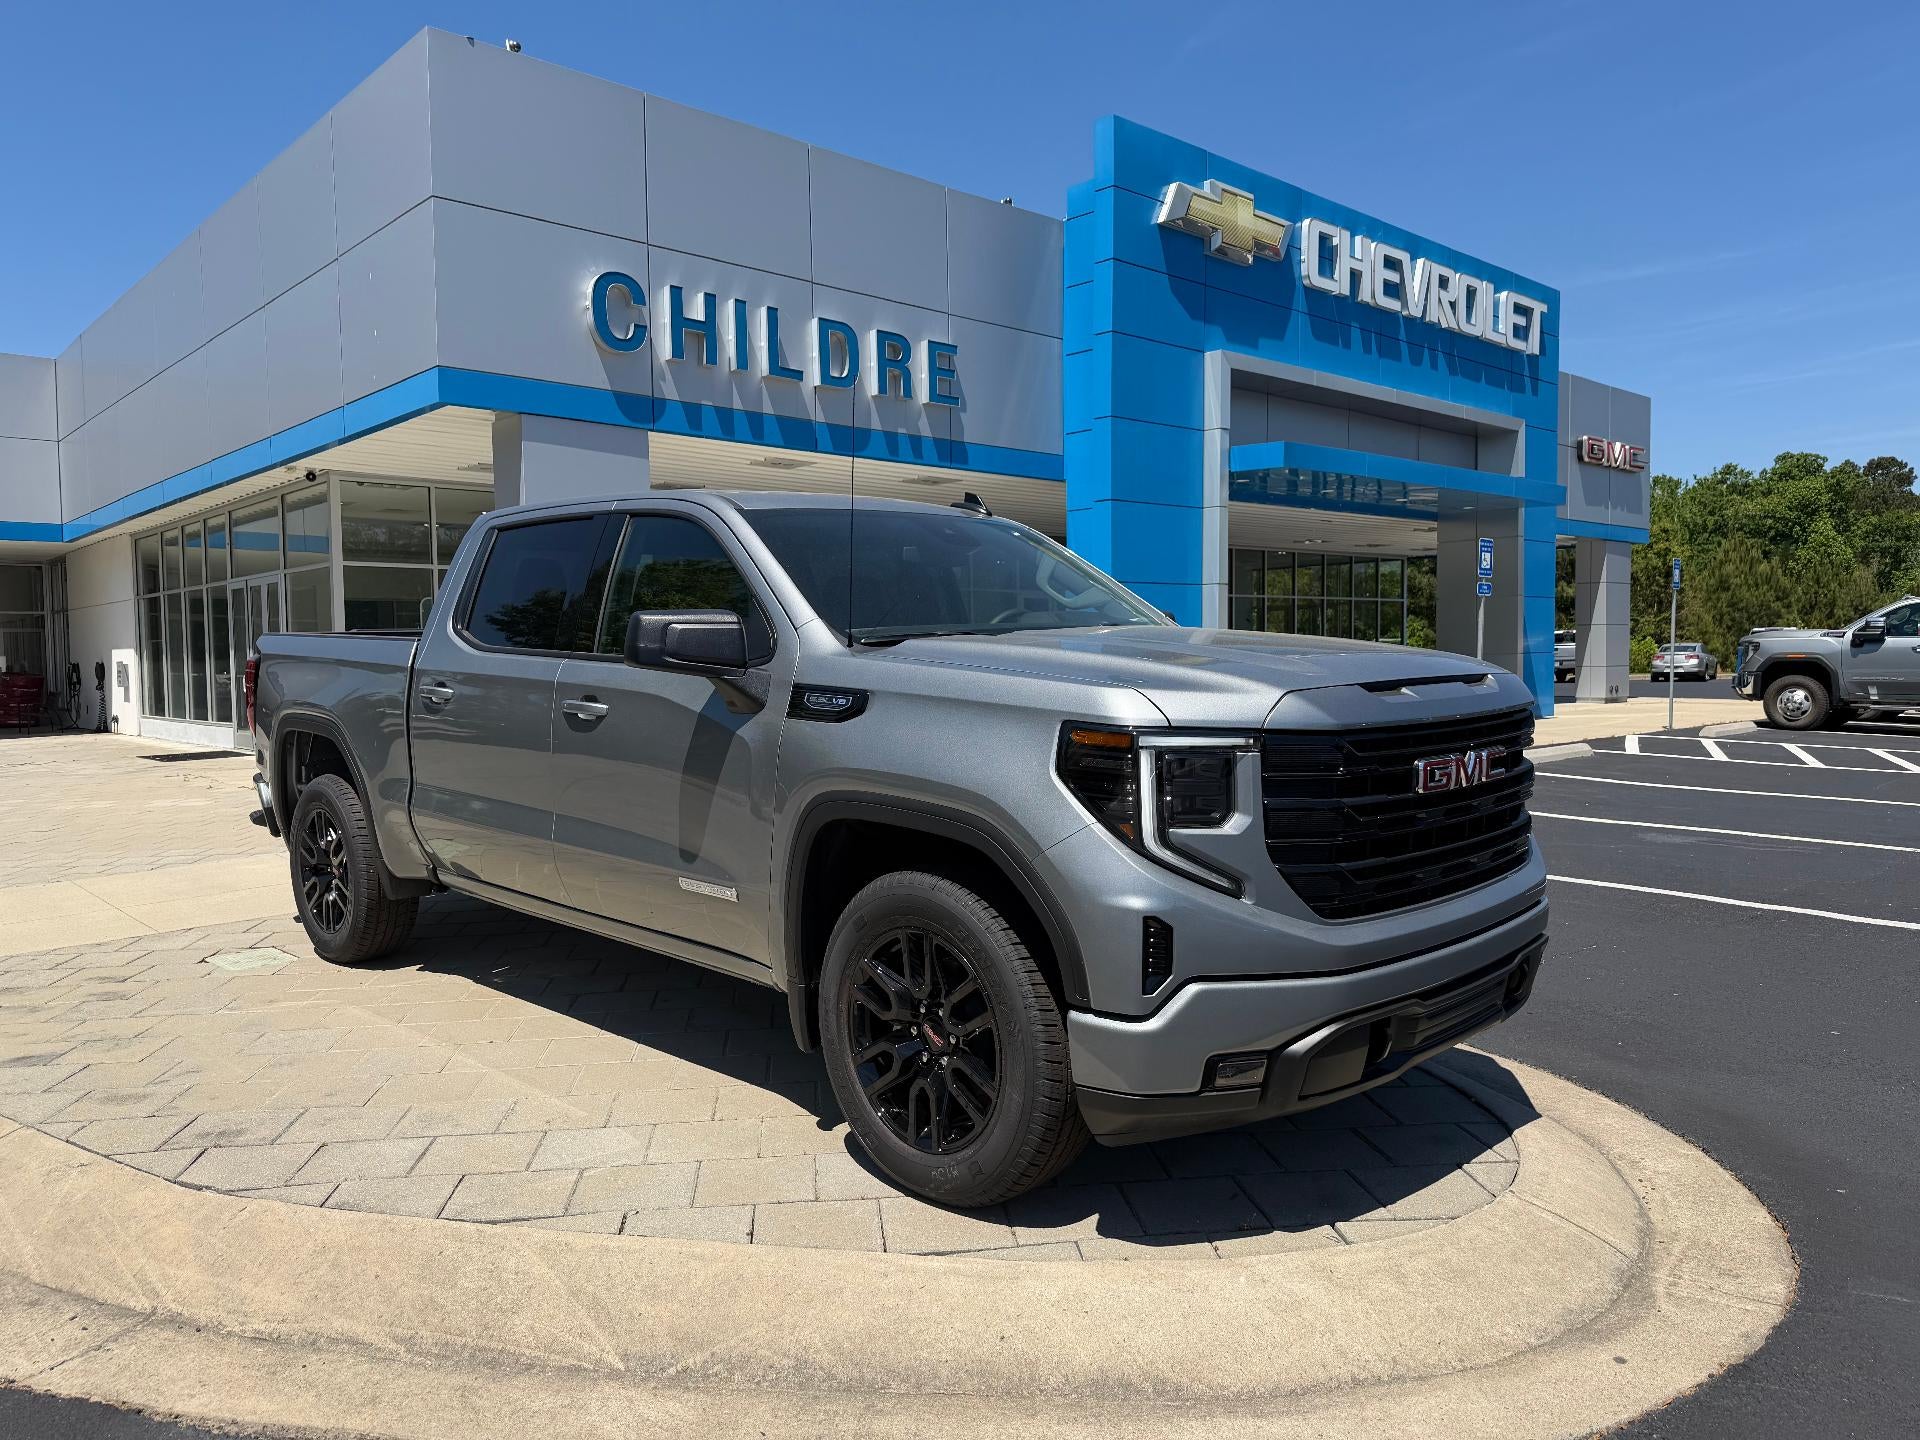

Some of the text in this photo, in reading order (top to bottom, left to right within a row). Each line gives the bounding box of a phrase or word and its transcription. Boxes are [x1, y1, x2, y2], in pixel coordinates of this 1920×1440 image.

[1301, 217, 1548, 355] CHEVROLET
[587, 271, 960, 407] CHILDRE
[1579, 435, 1646, 472] GMC
[1415, 747, 1505, 793] GMC
